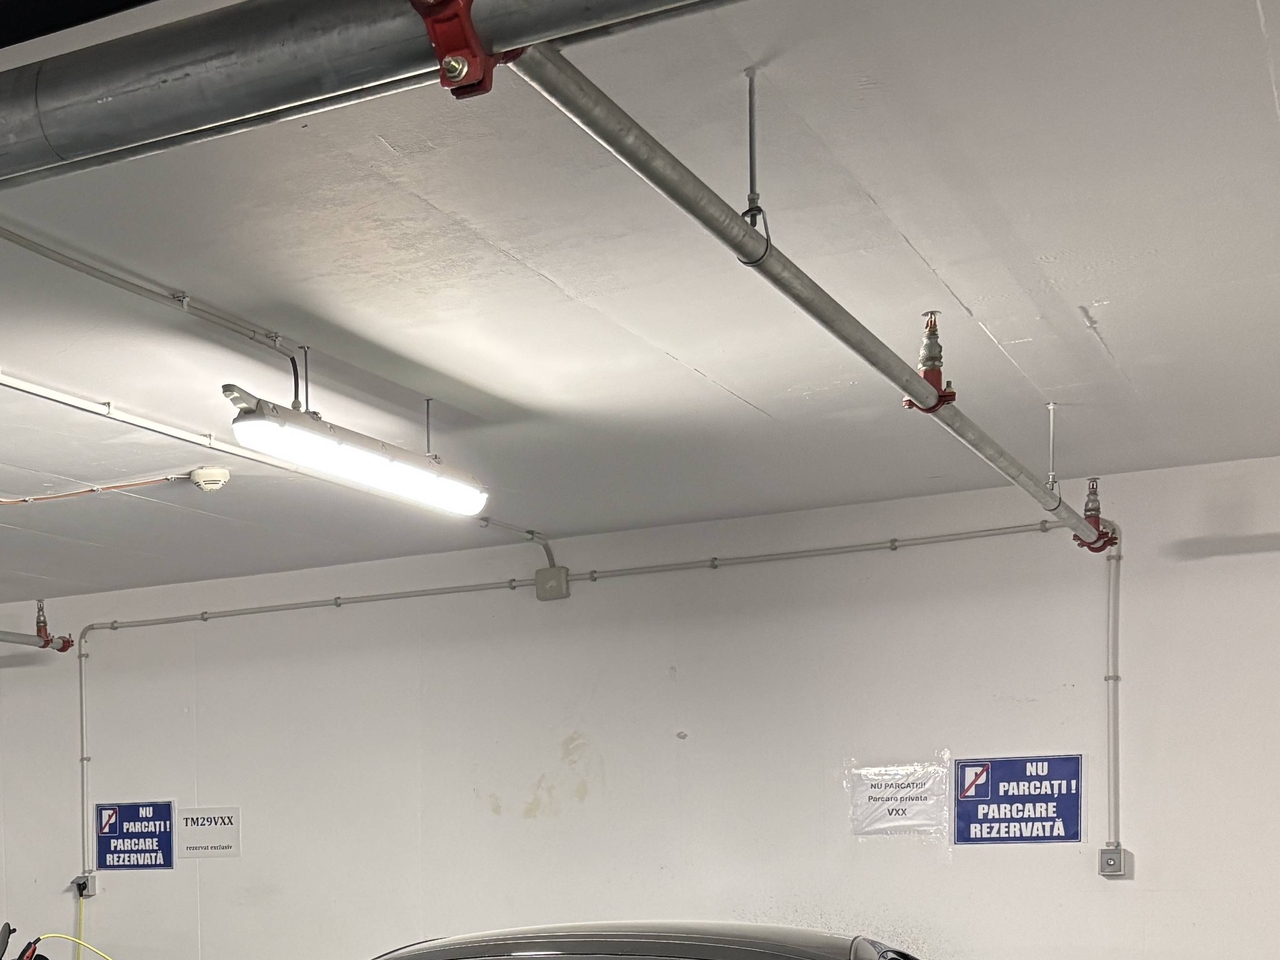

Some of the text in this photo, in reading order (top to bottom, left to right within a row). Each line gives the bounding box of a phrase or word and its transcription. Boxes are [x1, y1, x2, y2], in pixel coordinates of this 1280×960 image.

[1026, 762, 1049, 776] NU
[999, 780, 1067, 798] PARCAȚI
[139, 807, 153, 818] NU
[887, 808, 907, 816] VXX
[977, 802, 1057, 819] PARCARE
[123, 821, 165, 835] PARCAȚI
[183, 816, 234, 827] TM29VXX
[970, 818, 1066, 839] REZERVATĂ
[110, 838, 159, 850] PARCARE
[106, 850, 164, 866] REZERVATĂ
